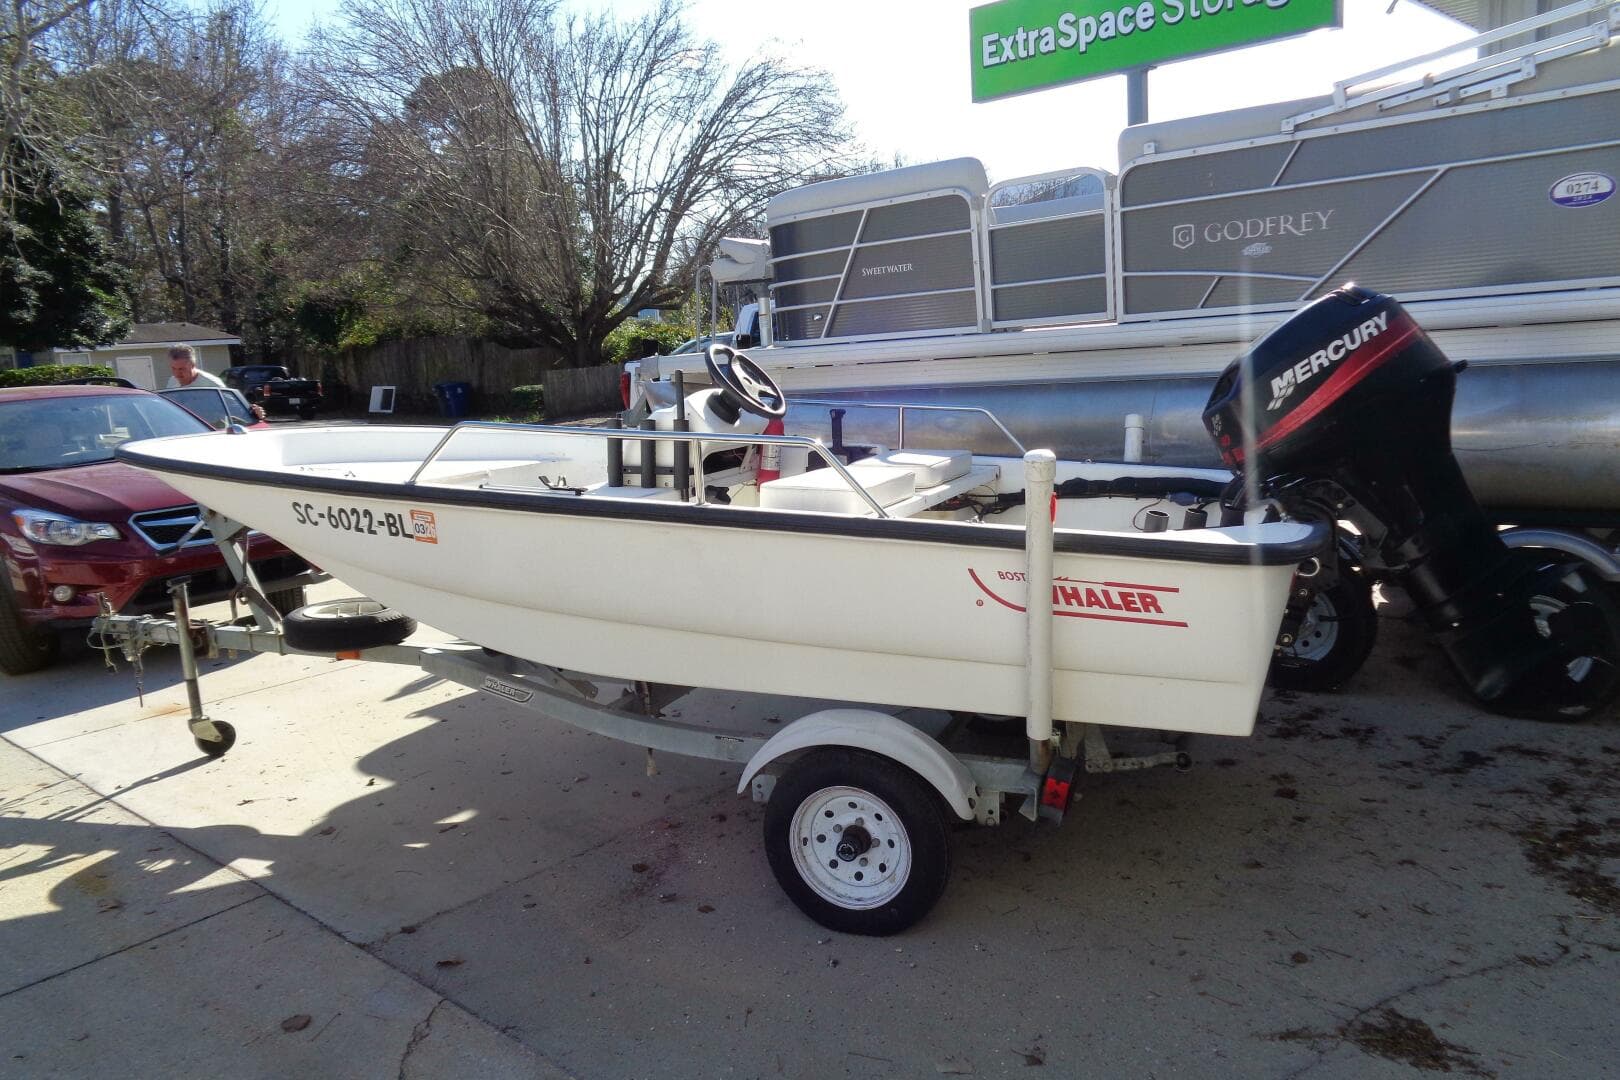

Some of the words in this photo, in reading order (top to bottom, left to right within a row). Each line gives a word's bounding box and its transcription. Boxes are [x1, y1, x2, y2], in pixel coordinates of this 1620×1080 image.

[1566, 180, 1599, 195] 0274
[1204, 209, 1335, 243] GODFREY
[1267, 311, 1389, 410] MERCURY
[292, 501, 414, 539] SC-6022-BL
[997, 570, 1026, 582] BOST
